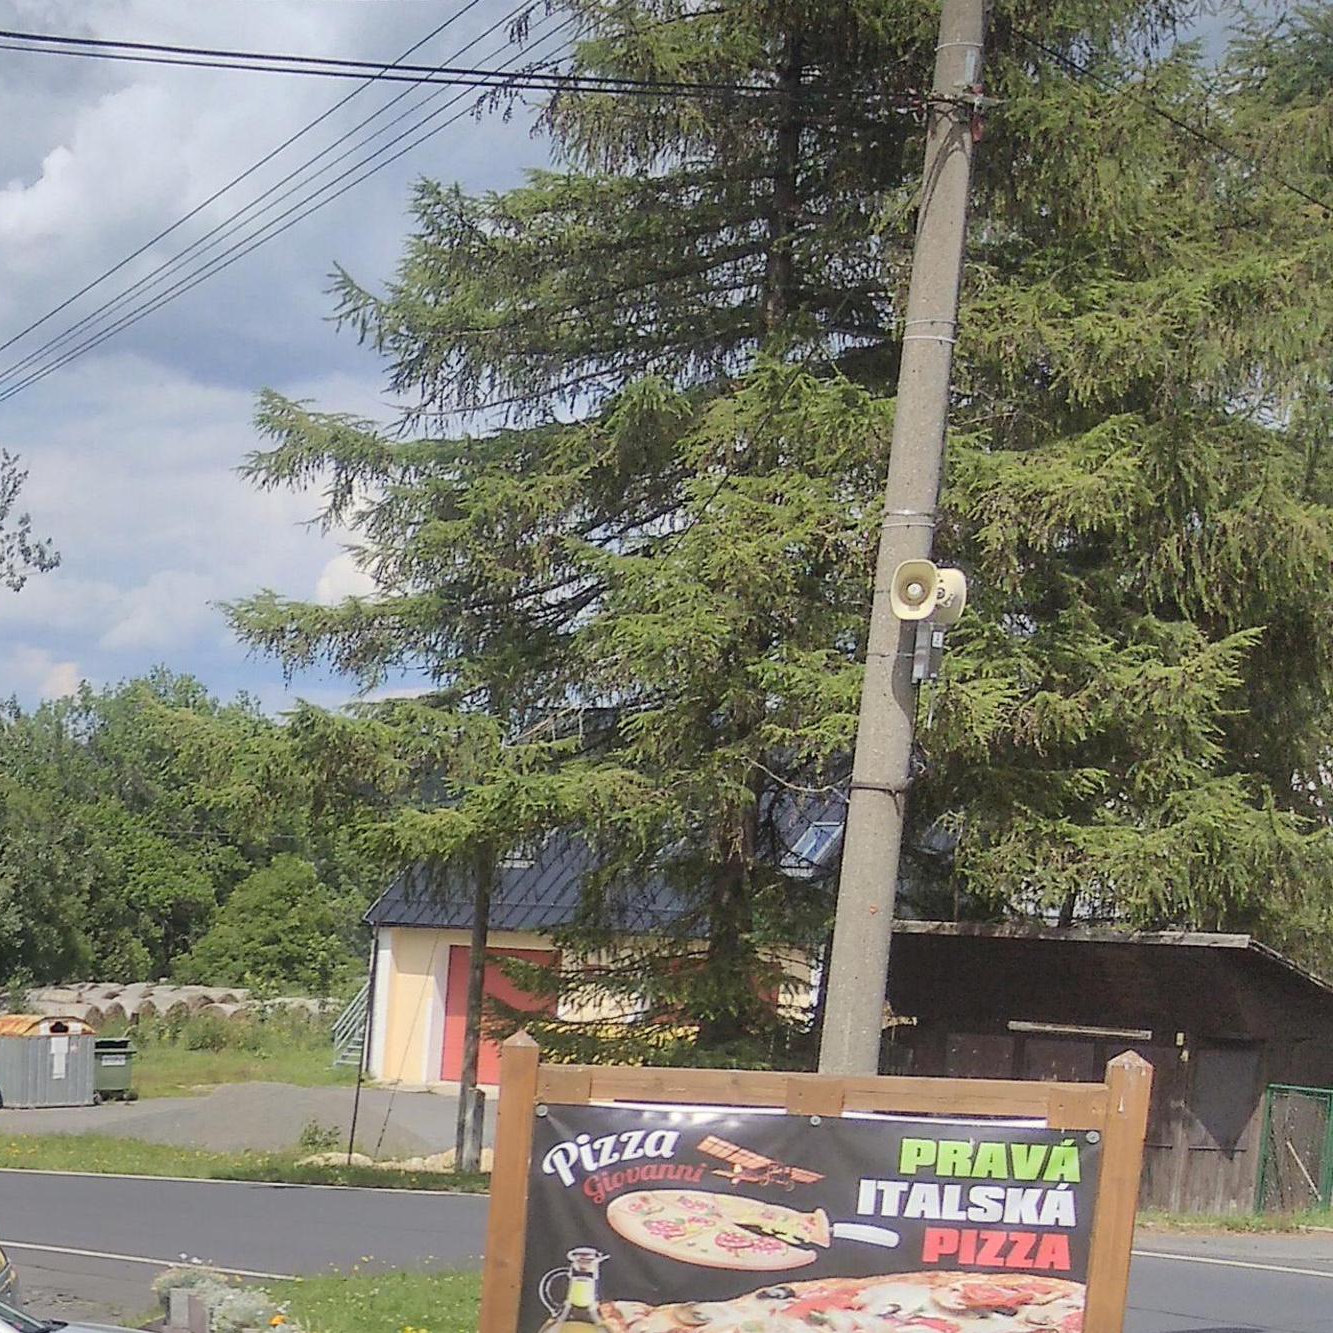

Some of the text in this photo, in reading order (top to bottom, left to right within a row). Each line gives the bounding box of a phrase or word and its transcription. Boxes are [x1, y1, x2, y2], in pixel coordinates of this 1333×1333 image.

[541, 1130, 680, 1187] Pizza
[899, 1137, 1082, 1183] PRAVÁ
[583, 1162, 708, 1204] Giovanni
[856, 1178, 1077, 1227] ITALSKÁ
[922, 1227, 1072, 1271] PIZZA
